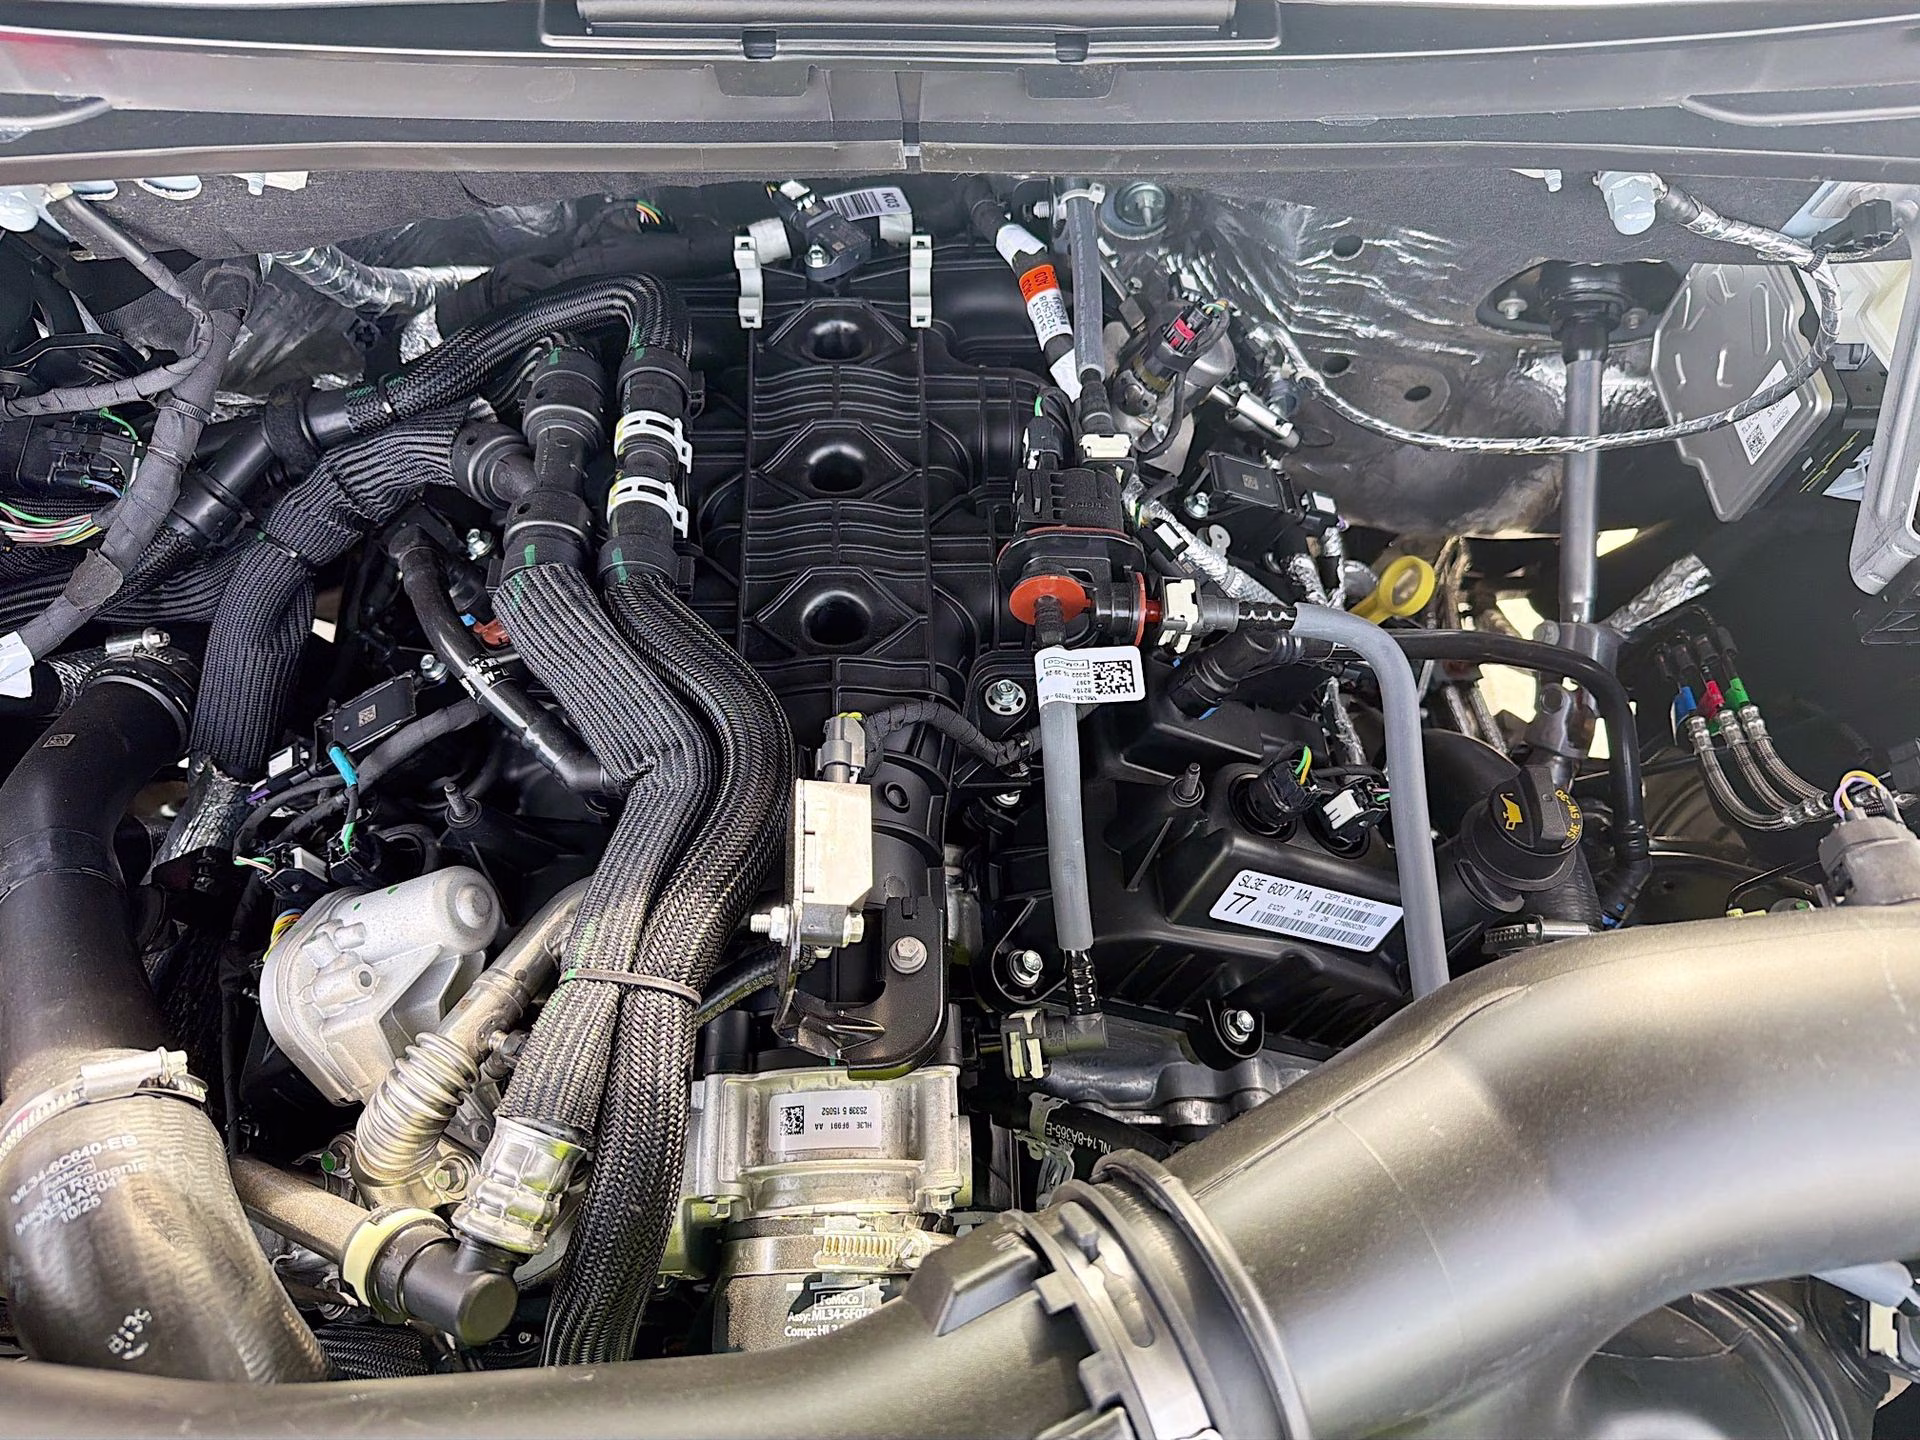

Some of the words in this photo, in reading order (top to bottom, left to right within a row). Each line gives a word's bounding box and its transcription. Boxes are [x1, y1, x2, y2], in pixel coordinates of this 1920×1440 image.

[881, 192, 900, 208] K03
[1554, 789, 1580, 819] 5W-30
[1566, 822, 1581, 839] SAE
[1238, 874, 1267, 891] SL3E
[1266, 882, 1295, 897] 6007
[1293, 888, 1313, 902] MA
[1224, 891, 1257, 914] 77
